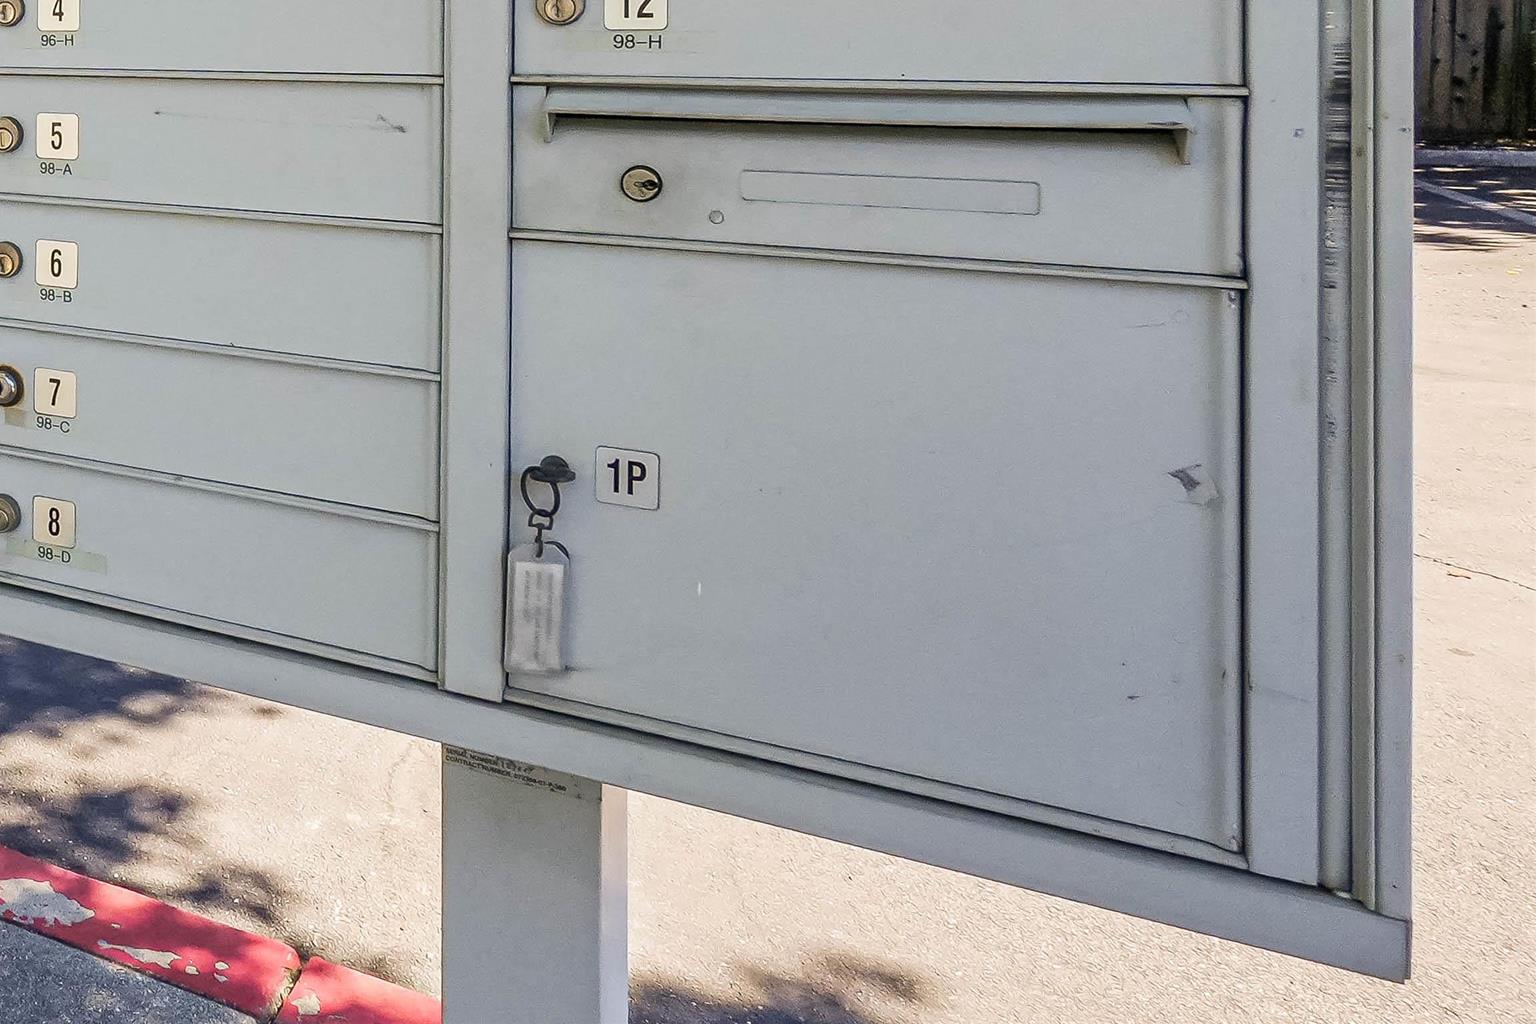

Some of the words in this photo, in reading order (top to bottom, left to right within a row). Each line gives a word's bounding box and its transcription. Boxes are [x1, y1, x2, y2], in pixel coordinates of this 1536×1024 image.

[41, 34, 74, 47] 96-H
[613, 34, 662, 50] 98-H
[50, 122, 63, 150] 5
[39, 162, 72, 176] 98-A
[50, 249, 62, 277] 6
[40, 288, 72, 303] 98-B
[48, 378, 61, 406] 7
[36, 417, 70, 434] 98-C
[607, 458, 647, 496] 1P
[48, 507, 60, 536] 8
[38, 546, 71, 563] 98-D
[445, 755, 482, 769] CONTRACT
